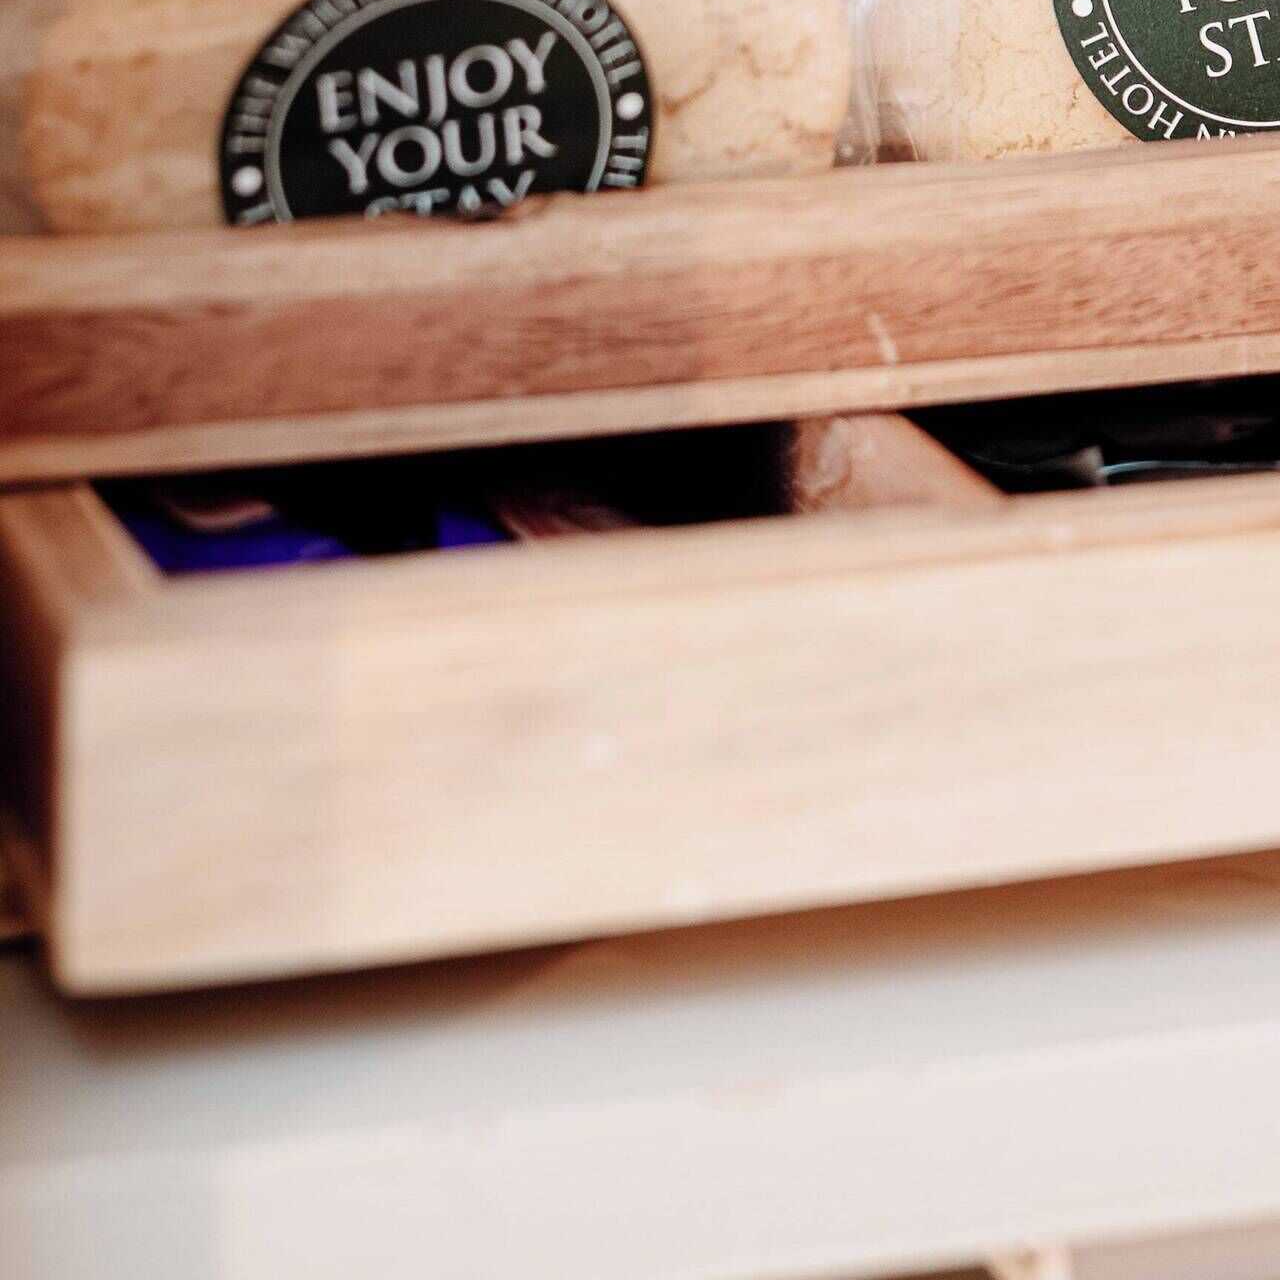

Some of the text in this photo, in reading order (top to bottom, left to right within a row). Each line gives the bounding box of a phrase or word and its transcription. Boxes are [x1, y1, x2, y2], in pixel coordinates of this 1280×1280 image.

[315, 31, 559, 133] ENJOY
[1080, 22, 1185, 139] HOTEL
[328, 103, 559, 195] YOUR
[603, 126, 649, 187] TH
